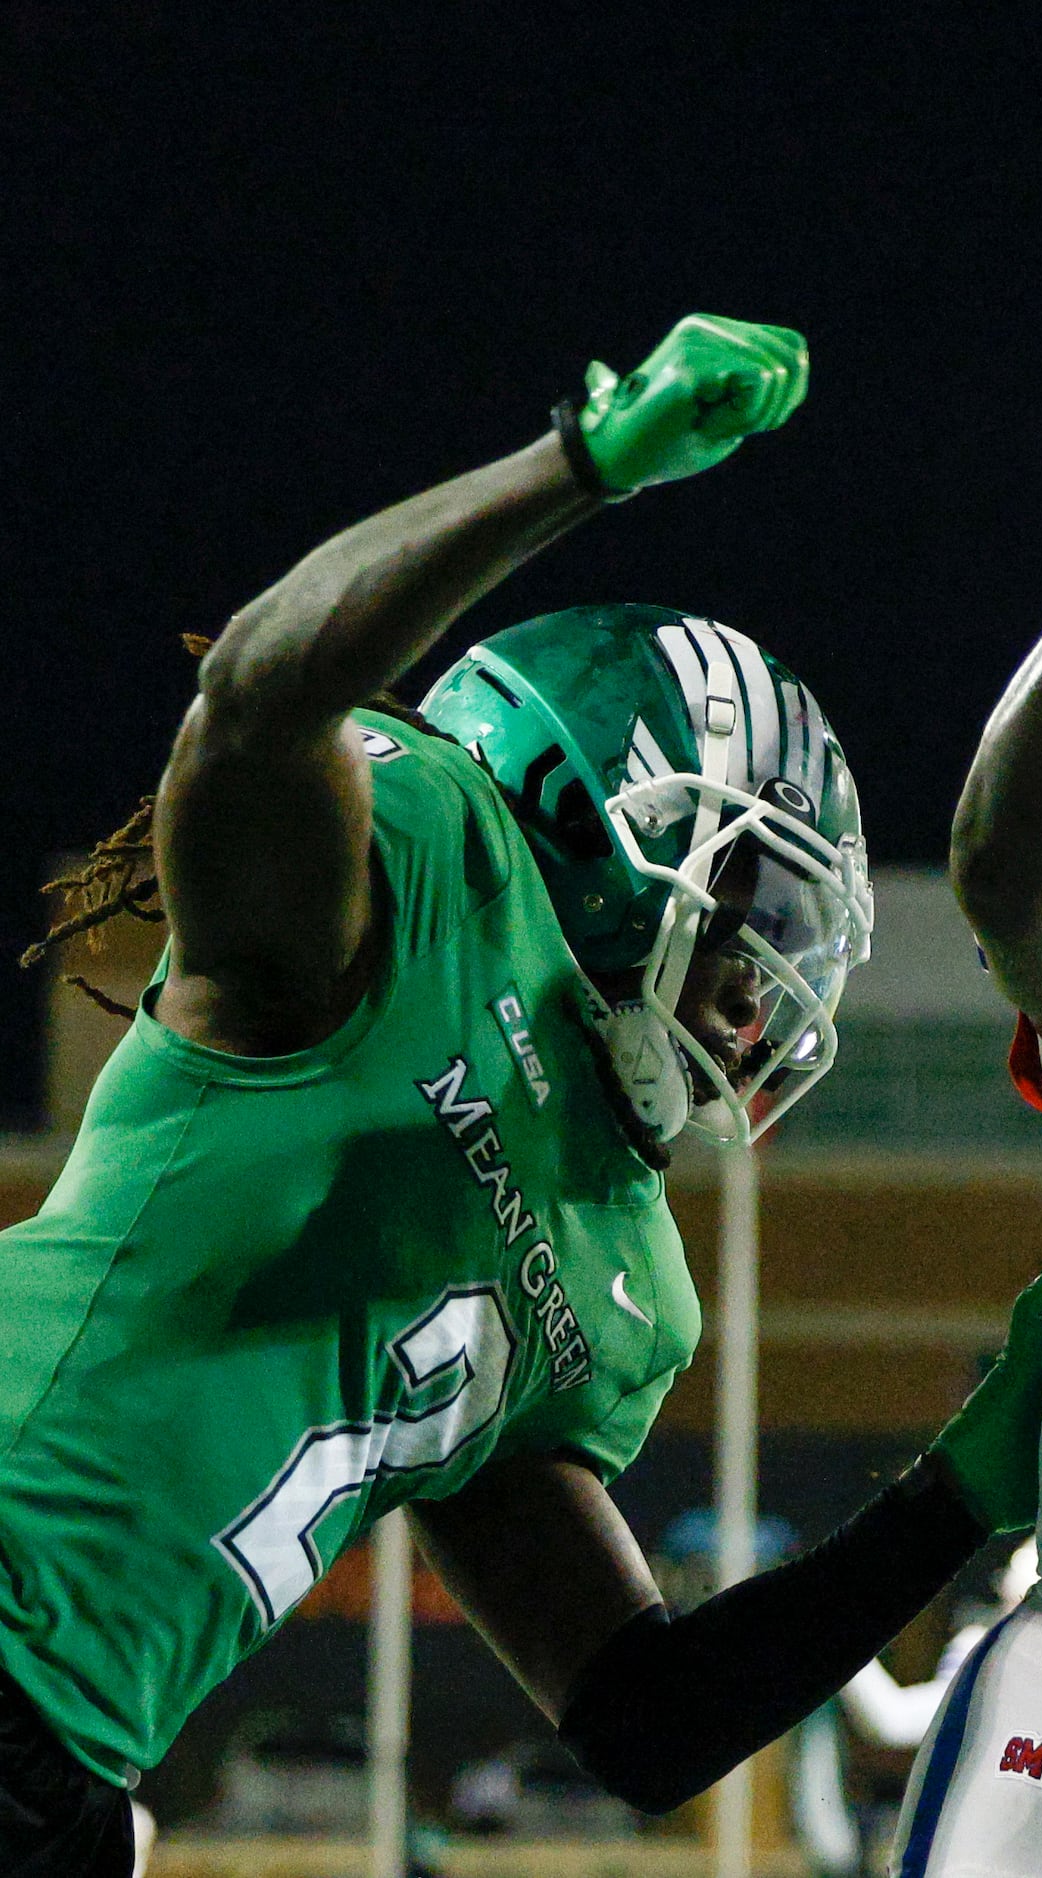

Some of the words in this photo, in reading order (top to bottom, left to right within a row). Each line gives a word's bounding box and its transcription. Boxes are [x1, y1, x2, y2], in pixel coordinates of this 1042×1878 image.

[414, 1055, 538, 1249] MEAN
[520, 1240, 592, 1396] GREEN
[209, 1280, 520, 1633] 2
